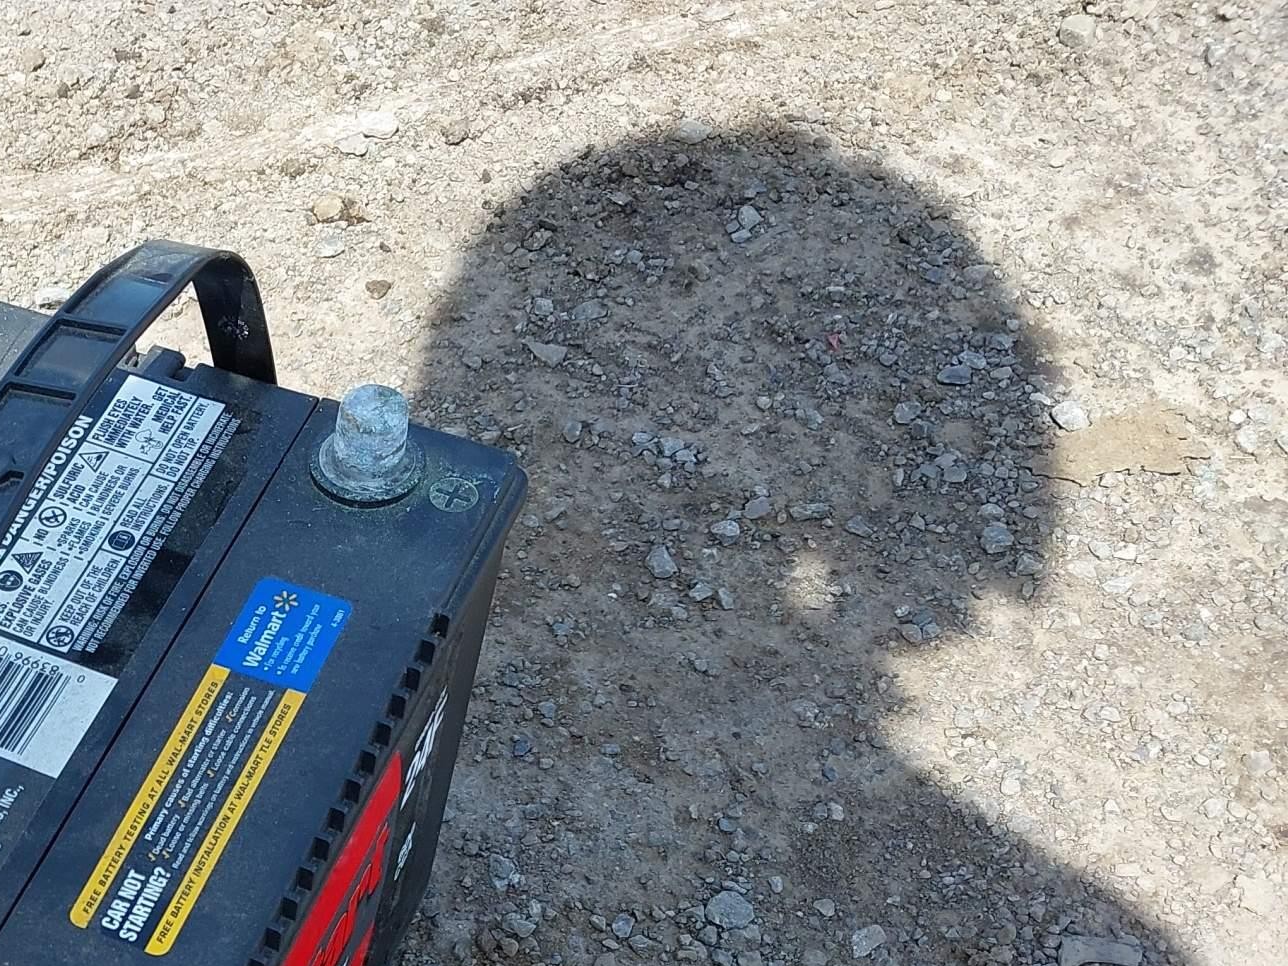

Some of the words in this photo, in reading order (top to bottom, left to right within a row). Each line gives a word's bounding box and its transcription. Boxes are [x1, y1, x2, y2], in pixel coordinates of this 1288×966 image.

[151, 386, 169, 401] GET
[151, 390, 180, 423] MEDICAL
[91, 417, 115, 441] FLUSH
[107, 398, 128, 418] EYES
[103, 395, 144, 445] IMMEDIATELY
[115, 428, 136, 449] WITH
[128, 400, 155, 429] WATER.
[158, 414, 179, 434] HELP
[171, 394, 193, 415] FAST.
[155, 462, 169, 473] DO
[162, 448, 178, 463] NOT
[171, 430, 190, 449] OPEN
[183, 401, 209, 431] BATTERY.
[165, 465, 180, 477] DO
[173, 450, 190, 465] NOT
[183, 435, 199, 450] TIP.
[52, 461, 85, 500] SULFURIC
[65, 483, 86, 504] ACID
[78, 493, 95, 508] CAN
[88, 470, 109, 493] CAUSE
[90, 475, 121, 512] BLINDNESS
[114, 464, 128, 475] OR
[101, 490, 125, 516] SEVERE
[118, 465, 142, 490] BURNS.
[119, 508, 139, 528] READ
[132, 496, 147, 509] ALL
[130, 482, 169, 531] INSTRUCTIONS.
[32, 527, 49, 541] NO
[27, 558, 53, 585] GASES
[90, 555, 122, 593] CHILDREN.
[12, 618, 28, 633] CAN
[22, 594, 44, 618] CAUSE
[37, 556, 69, 594] BLINDNESS
[58, 603, 78, 622] KEEP
[70, 589, 87, 603] OUT
[79, 578, 93, 589] OF
[86, 564, 103, 579] THE
[84, 592, 98, 603] OF
[23, 625, 37, 637] OR
[30, 597, 55, 625] INJURY.
[69, 602, 92, 626] REACH
[236, 614, 262, 643] Return
[254, 604, 267, 615] to
[241, 609, 288, 669] Walmart
[13, 652, 60, 676] 83996
[76, 674, 86, 684] 0
[202, 690, 235, 736] difficulties:
[227, 686, 251, 717] Corrosion
[184, 735, 210, 768] starting
[211, 751, 227, 770] Loose
[221, 733, 236, 751] cable
[231, 695, 258, 733] connections
[179, 767, 190, 777] of
[81, 888, 102, 914] FREE
[96, 843, 127, 887] BATTERY
[122, 801, 151, 841] TESTING
[146, 786, 159, 800] AT
[154, 768, 169, 785] ALL
[165, 716, 199, 766] WAL-MART
[193, 680, 219, 716] STORES
[163, 777, 185, 808] causes
[143, 807, 169, 841] Primary
[151, 836, 167, 854] Dead
[161, 812, 181, 837] battery
[154, 919, 175, 943] FREE
[168, 877, 199, 918] BATTERY
[189, 814, 234, 877] INSTALLATION
[225, 801, 238, 813] AT
[232, 753, 265, 800] WAL-MART
[258, 737, 273, 753] TLE
[266, 703, 292, 736] STORES
[99, 897, 132, 931] CAR
[116, 868, 148, 900] NOT
[115, 865, 175, 942] STARTING?
